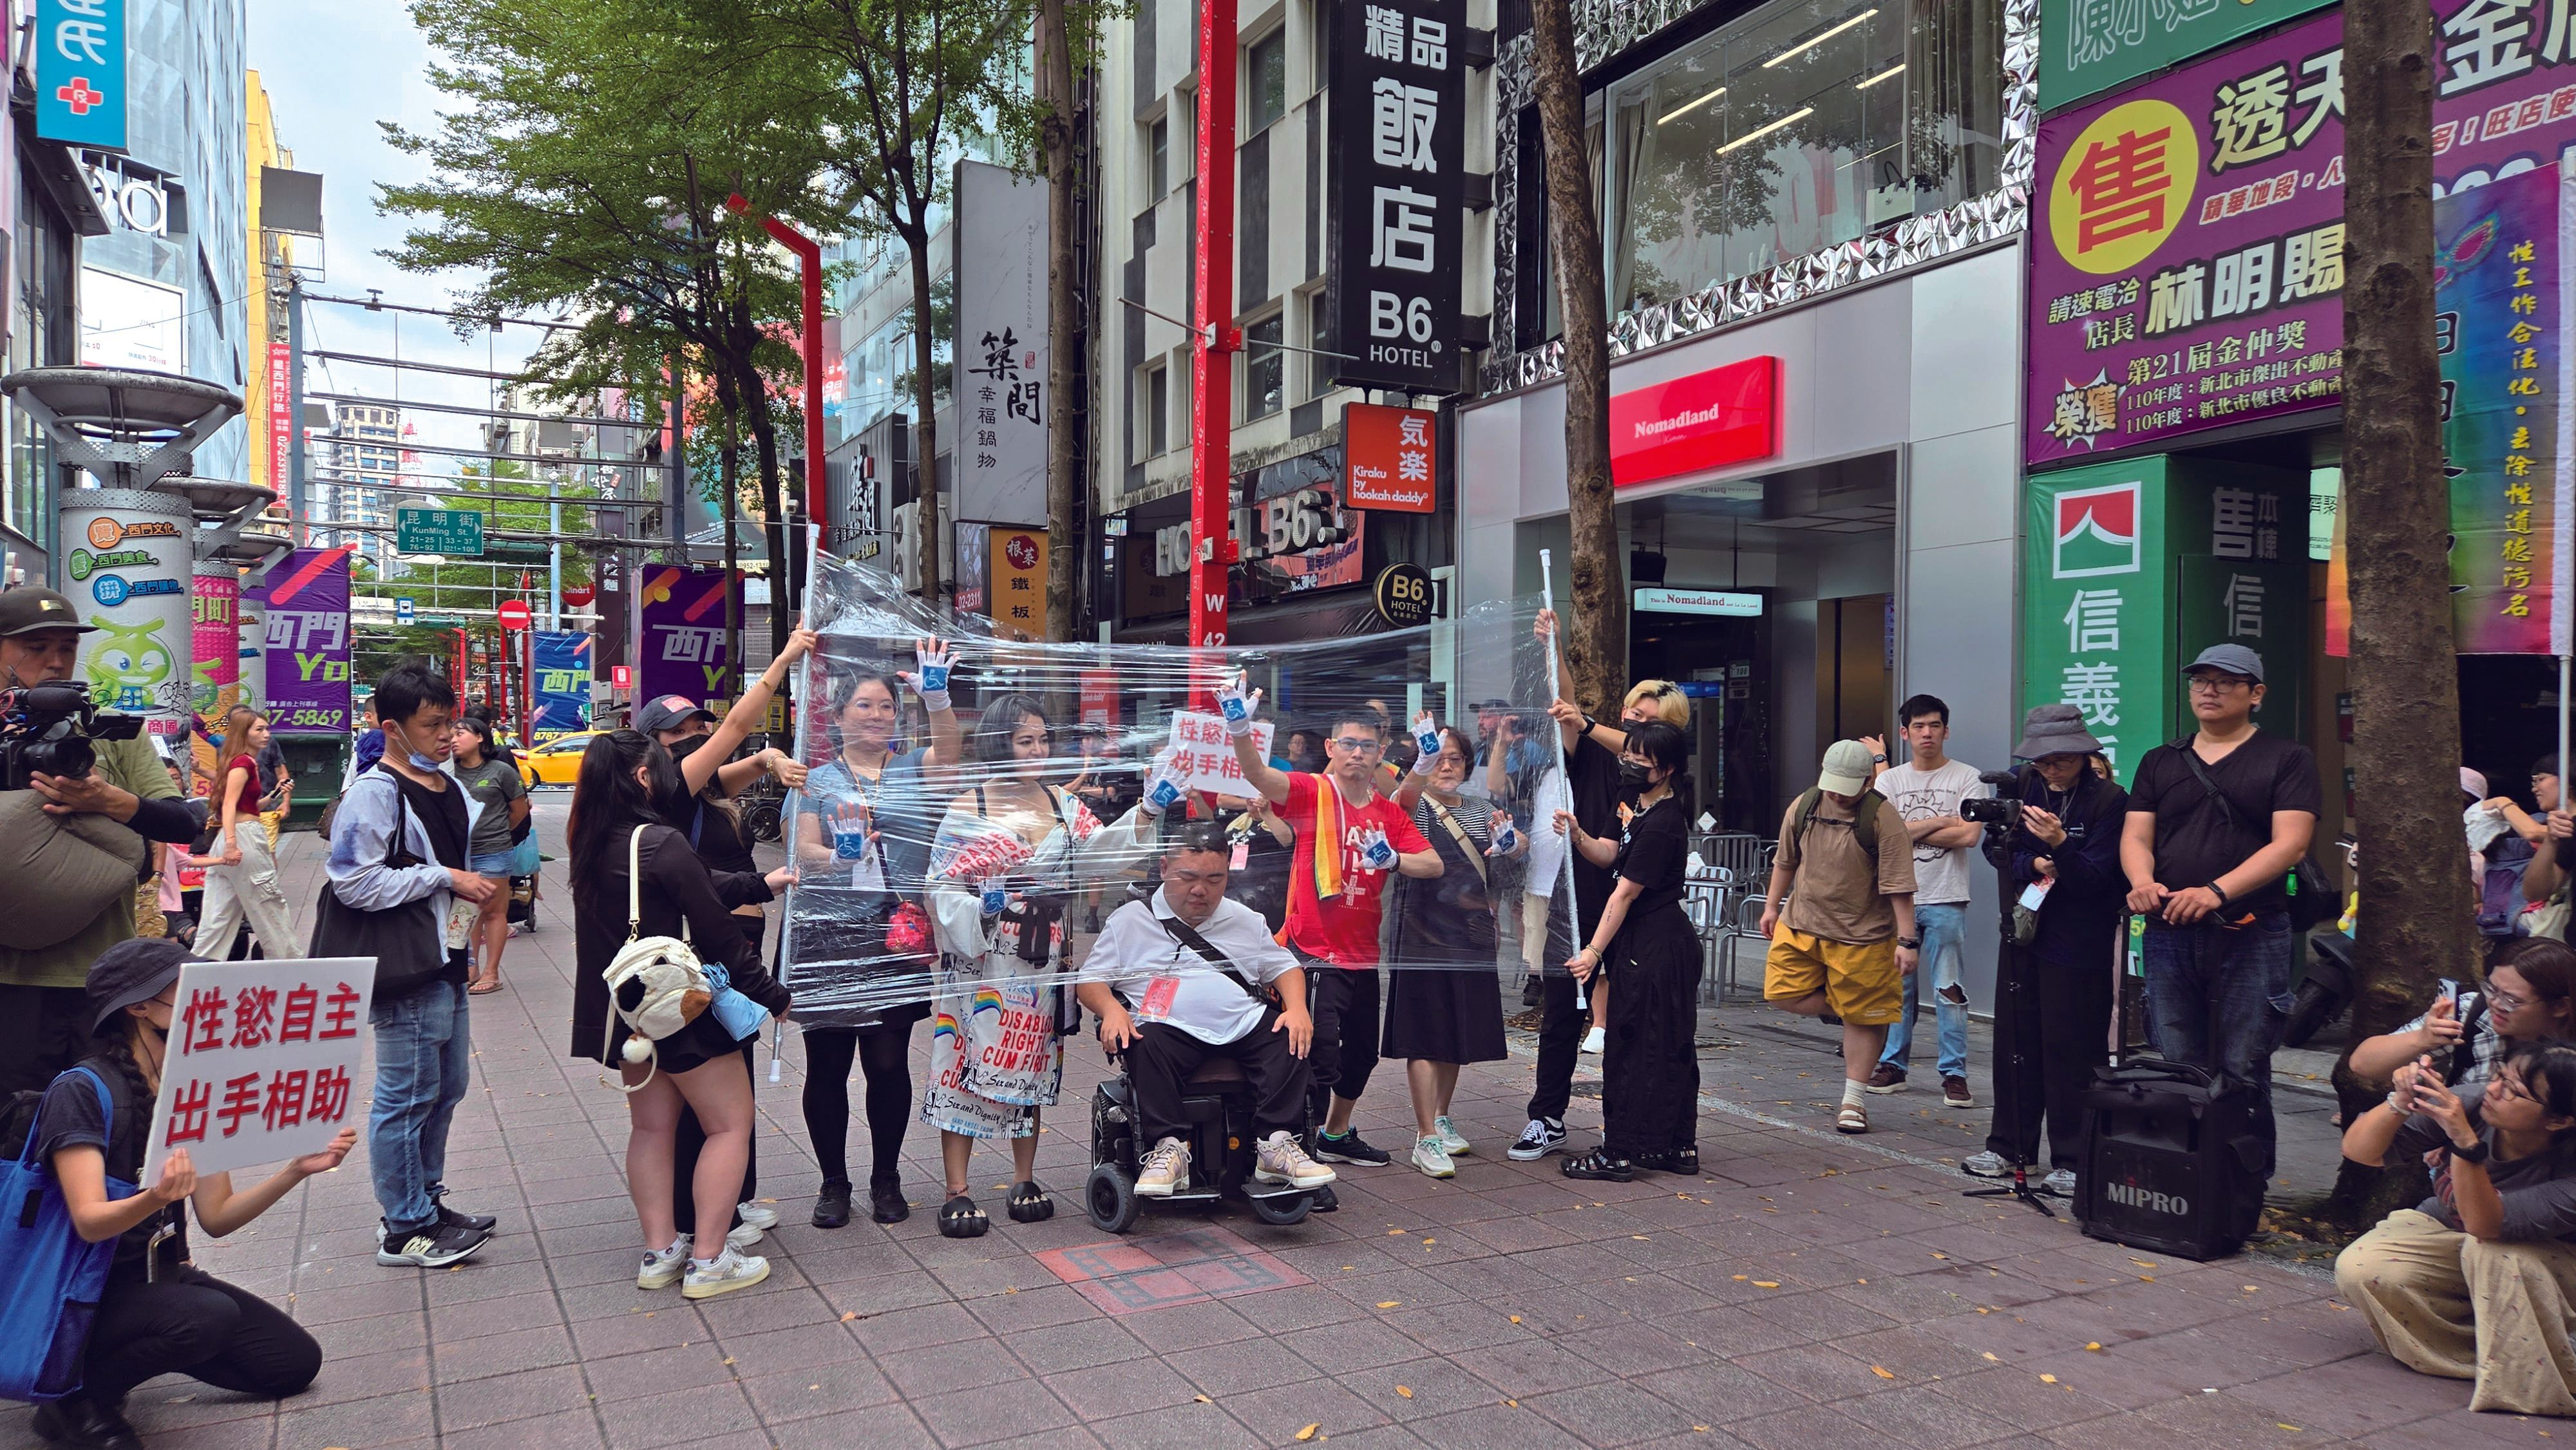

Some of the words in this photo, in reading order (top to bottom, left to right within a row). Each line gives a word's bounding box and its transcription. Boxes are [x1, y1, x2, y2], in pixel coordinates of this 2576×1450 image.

[1365, 5, 1447, 70] 精品
[1370, 77, 1439, 274] 飯店
[2069, 124, 2173, 254] 售
[1370, 290, 1433, 343] B6
[2047, 277, 2143, 325] 請速電洽
[2085, 313, 2136, 351] 店長
[1370, 344, 1433, 368] HOTEL
[2126, 319, 2308, 387] 第21屆金仲獎
[967, 326, 1041, 426] 築間
[1634, 402, 1719, 438] Nomadland
[2055, 382, 2118, 438] 榮獲
[977, 386, 997, 469] 幸福鍋物
[1399, 415, 1428, 481] 気楽
[1353, 465, 1387, 479] Kiraku
[1353, 476, 1367, 491] by
[1353, 487, 1391, 502] hookah
[128, 522, 175, 536] 西門文化
[406, 511, 475, 527] 昆明街
[412, 527, 450, 536] KunMing
[1267, 489, 1320, 554] B6
[2212, 486, 2254, 558] 售
[2257, 492, 2279, 560] 本棟
[98, 551, 149, 565] 西門美食
[99, 580, 120, 600] 拼
[1205, 594, 1225, 612] W
[1392, 574, 1425, 601] B6
[1667, 594, 1725, 607] Nomadland
[1391, 600, 1423, 614] HOTEL
[1202, 631, 1226, 648] 42
[1175, 749, 1246, 780] 出手相
[182, 983, 362, 1056] 性慾自主
[982, 1046, 1018, 1069] CUM
[165, 1064, 352, 1149] 出手相助
[944, 1096, 960, 1109] Sex
[960, 1101, 974, 1113] and
